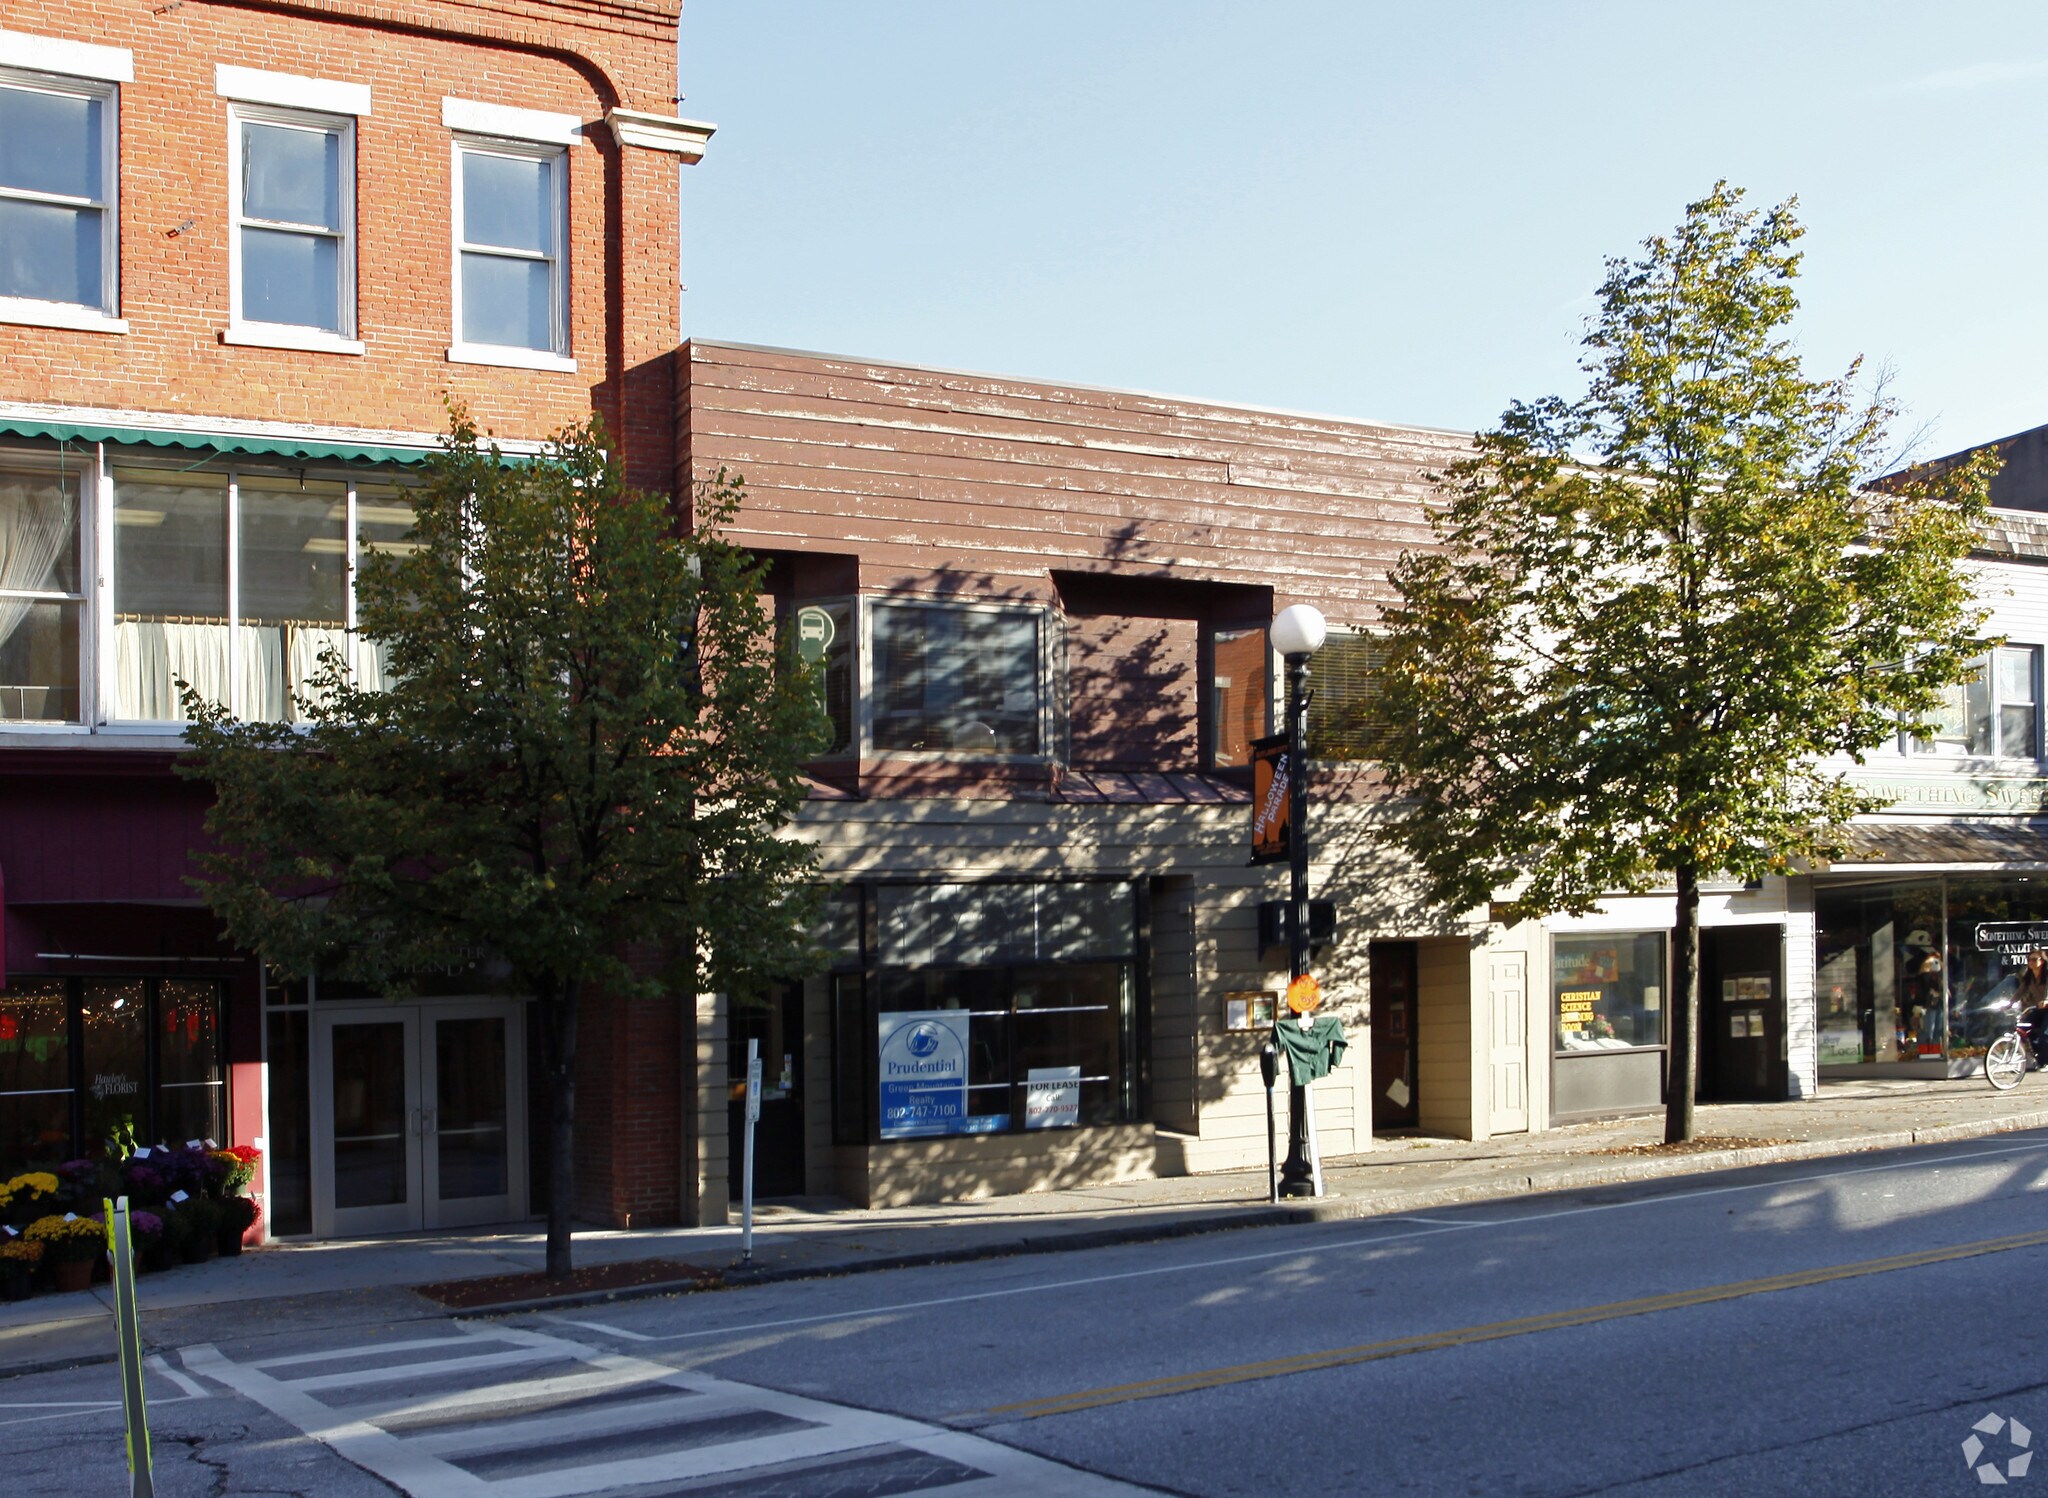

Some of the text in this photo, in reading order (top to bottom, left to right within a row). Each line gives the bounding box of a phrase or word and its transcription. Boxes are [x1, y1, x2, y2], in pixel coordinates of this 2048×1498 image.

[1254, 754, 1288, 834] HALLOWEEN
[1268, 773, 1289, 822] PARADE
[1986, 782, 2048, 807] SWEE
[1979, 929, 2025, 942] SOMETHING
[2001, 955, 2008, 965] &
[1561, 991, 1601, 1001] CHRISTIAN
[1560, 1002, 1592, 1012] SCIENCE
[1561, 1011, 1594, 1022] RDING
[1561, 1022, 1582, 1033] ROOM
[1831, 1043, 1860, 1056] Local
[888, 1059, 955, 1074] Prudential
[105, 1082, 138, 1094] FLORIST
[1030, 1080, 1079, 1091] FOR LEASE
[909, 1095, 935, 1105] Realty
[887, 1104, 956, 1119] 802-747-7100
